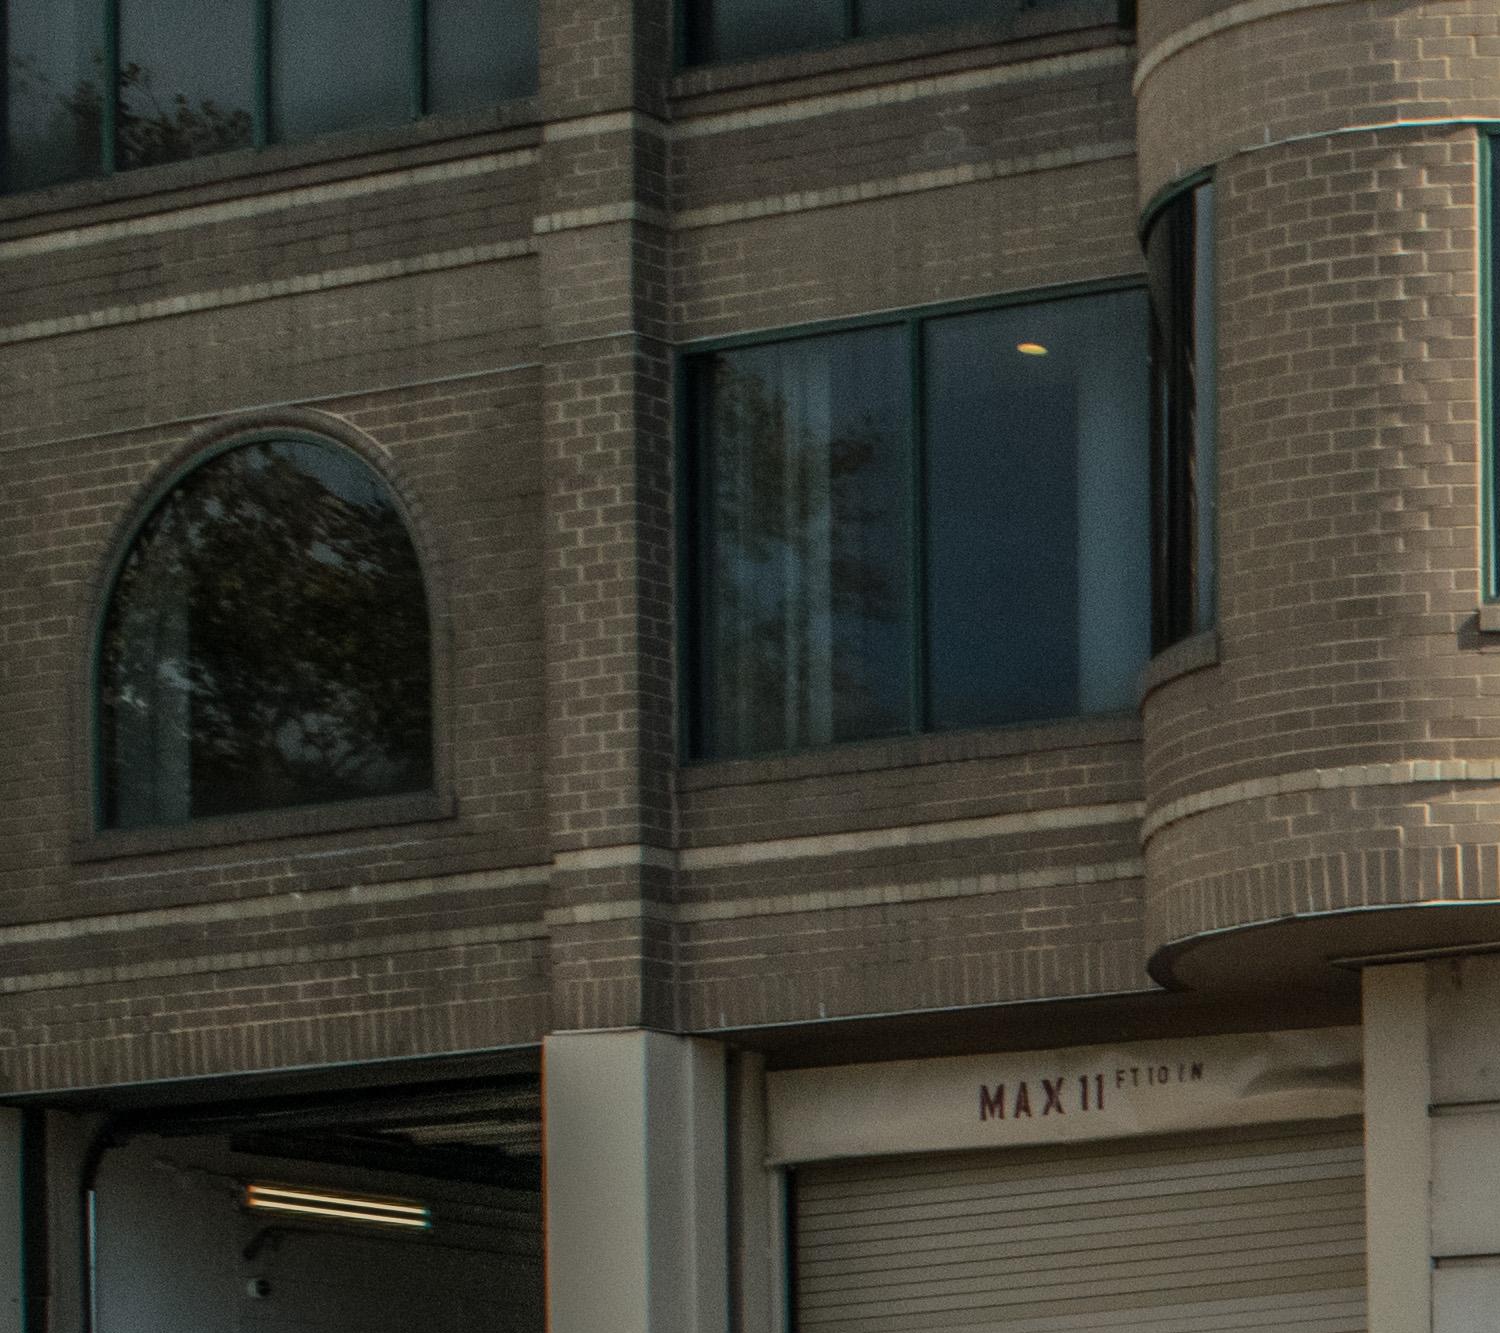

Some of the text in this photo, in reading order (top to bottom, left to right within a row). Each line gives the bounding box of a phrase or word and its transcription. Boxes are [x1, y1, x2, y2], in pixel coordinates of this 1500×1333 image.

[979, 1062, 1203, 1122] MAX 11 FT 10 IN
